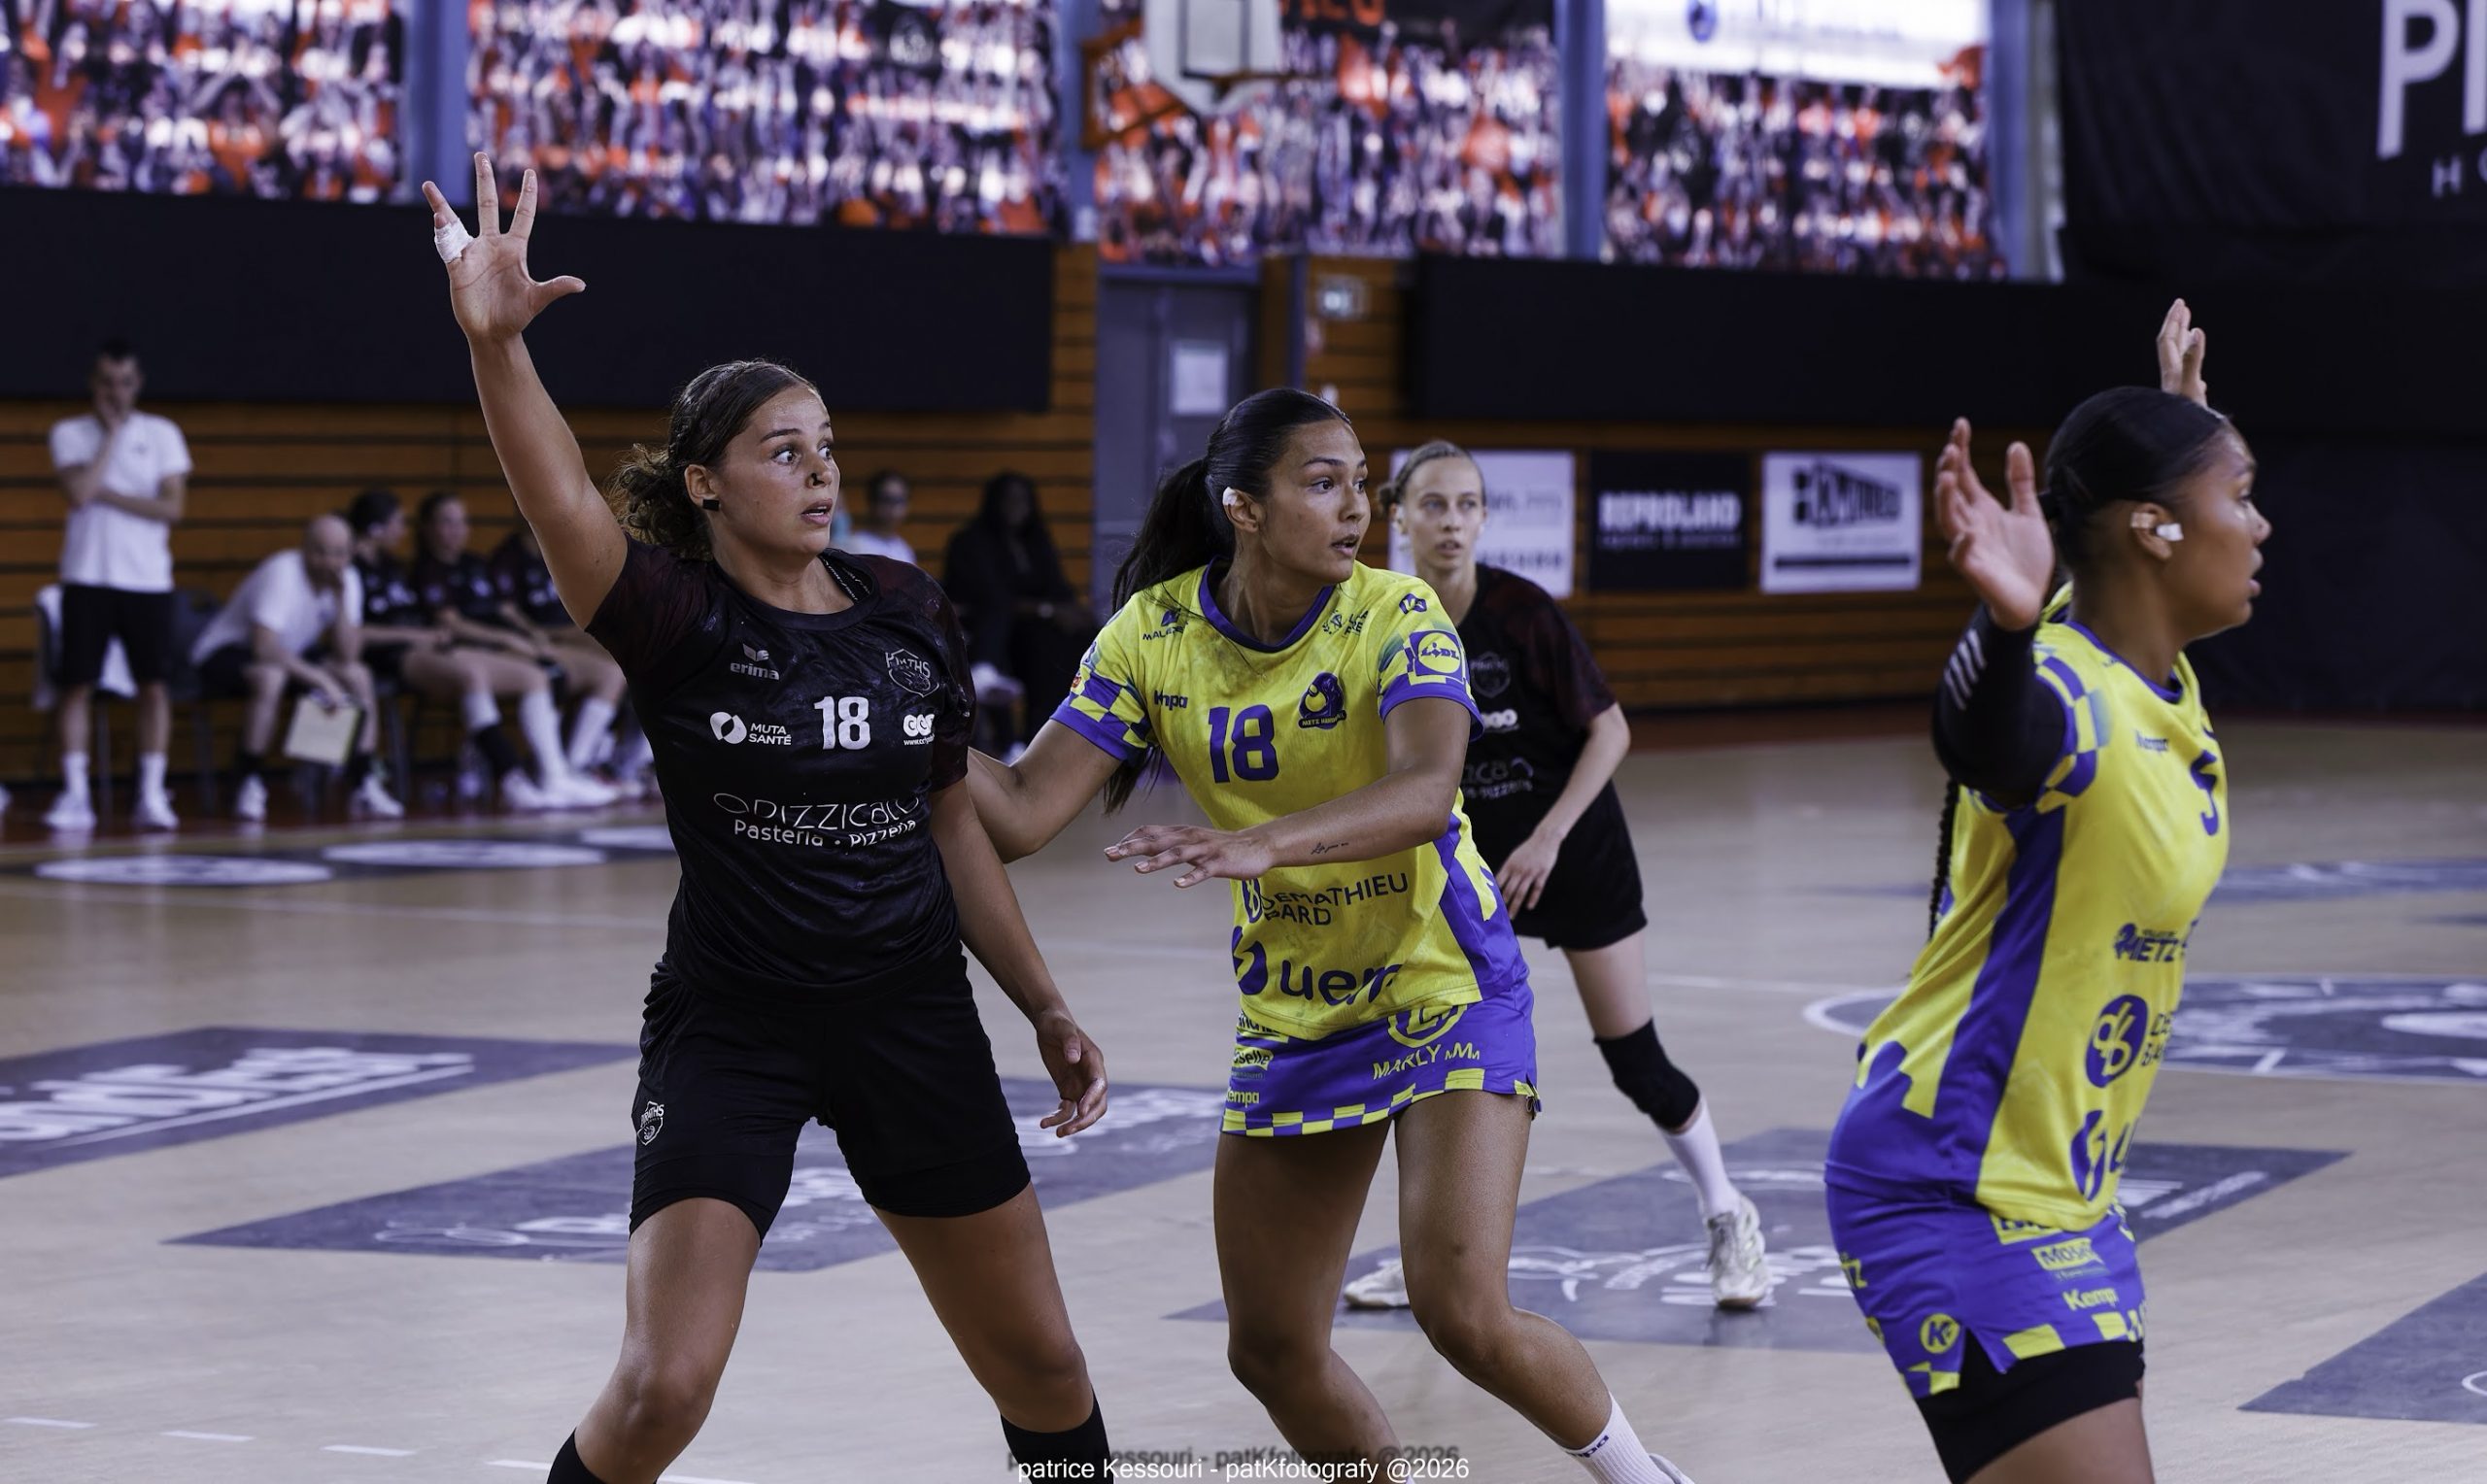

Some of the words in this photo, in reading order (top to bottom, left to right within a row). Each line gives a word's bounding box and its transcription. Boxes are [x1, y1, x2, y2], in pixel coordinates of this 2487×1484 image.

[730, 662, 780, 680] erima
[1154, 690, 1188, 711] Kmpa
[750, 723, 787, 735] MUTA
[813, 695, 871, 750] 18
[748, 733, 792, 746] SANTÉ
[1208, 705, 1279, 784] 18
[1233, 1049, 1271, 1065] selle
[1373, 1044, 1442, 1080] MARLY
[1227, 1088, 1260, 1108] empa
